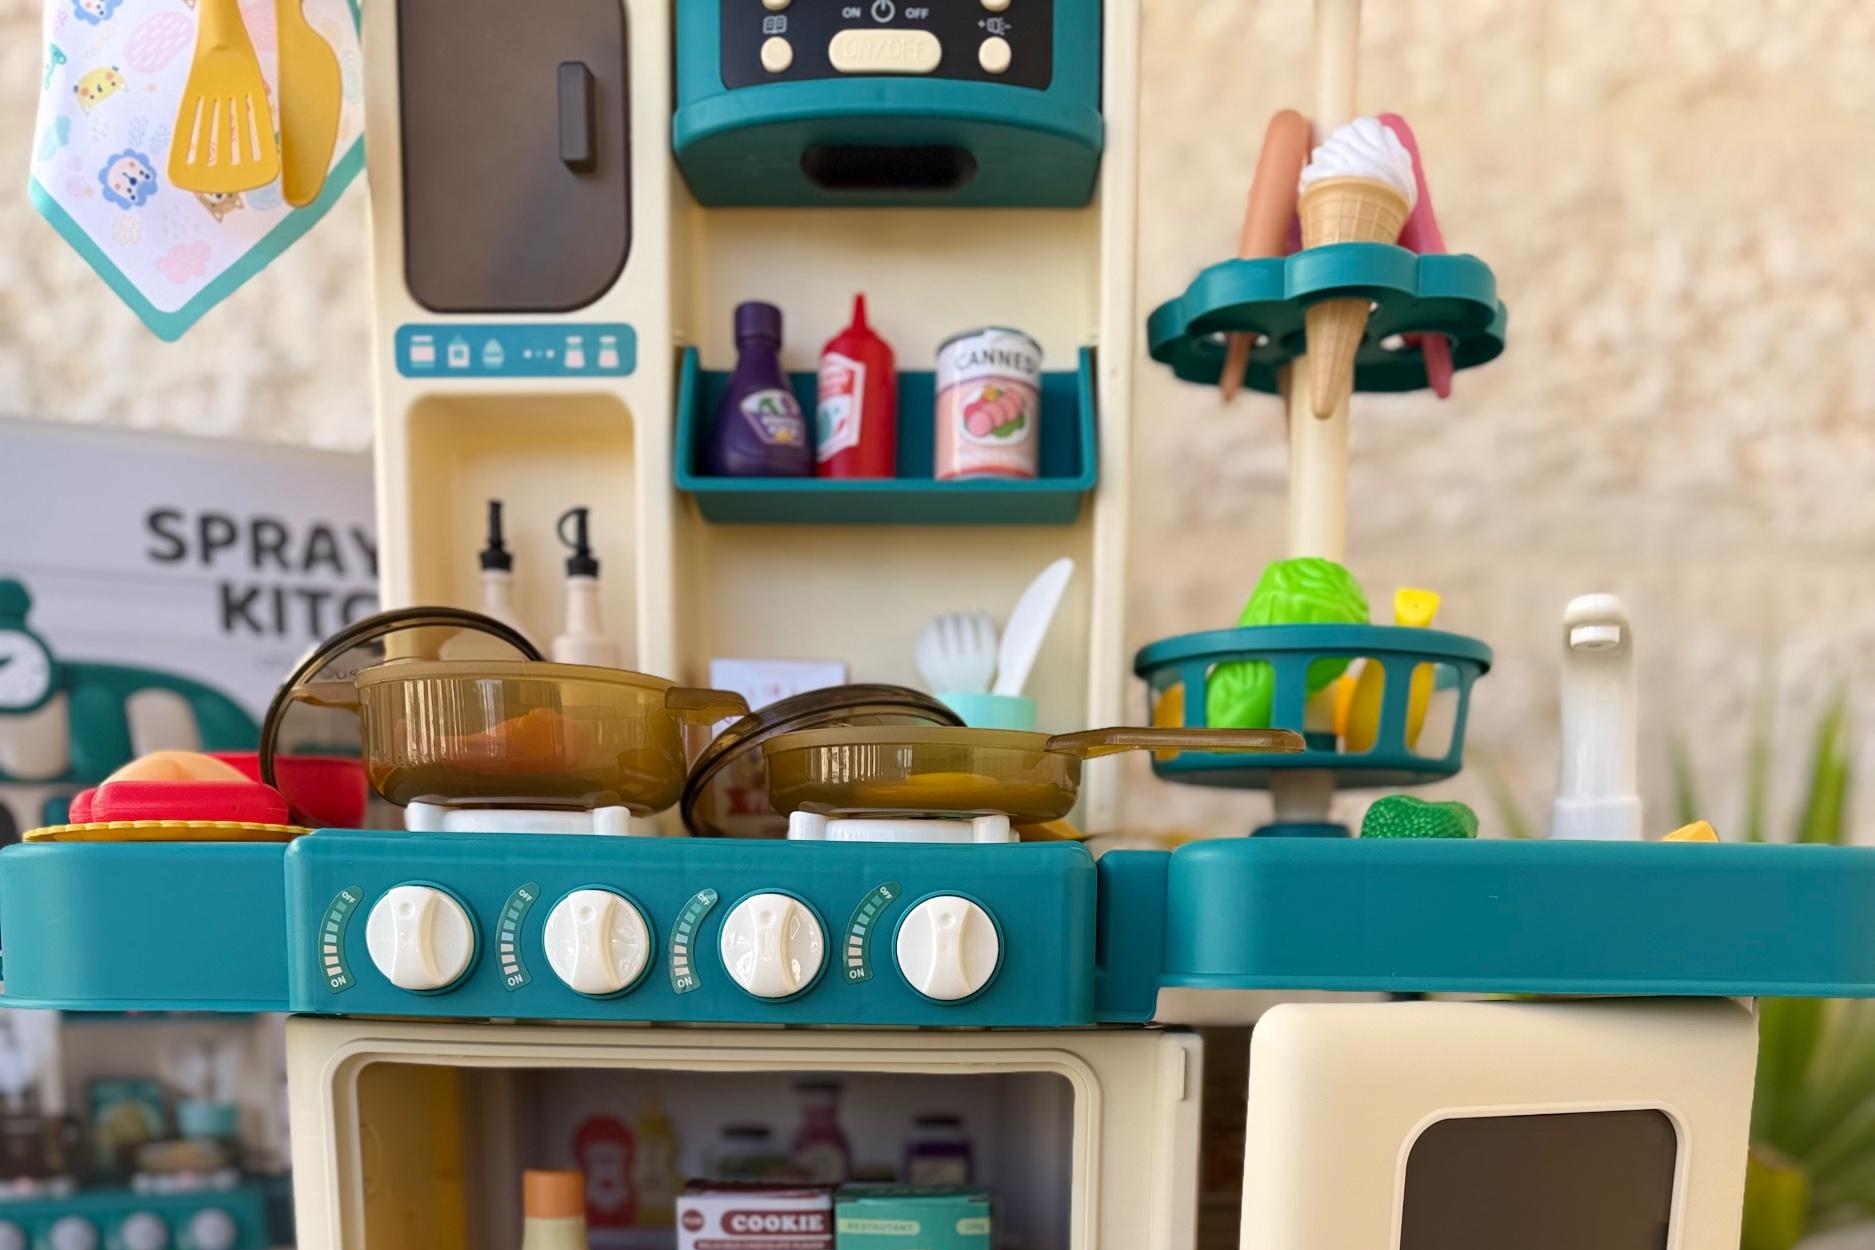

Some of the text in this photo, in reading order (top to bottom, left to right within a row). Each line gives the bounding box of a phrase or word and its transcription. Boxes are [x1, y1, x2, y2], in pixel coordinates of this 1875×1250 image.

[842, 7, 861, 19] ON
[905, 7, 929, 20] OFF
[845, 38, 929, 61] ON/OFF
[341, 891, 356, 904] OFF
[518, 889, 533, 902] OFF
[880, 886, 893, 900] OFF
[507, 973, 524, 986] ON
[849, 967, 865, 979] ON
[330, 975, 347, 988] ON
[676, 976, 693, 988] ON
[731, 1214, 824, 1232] COOKIE
